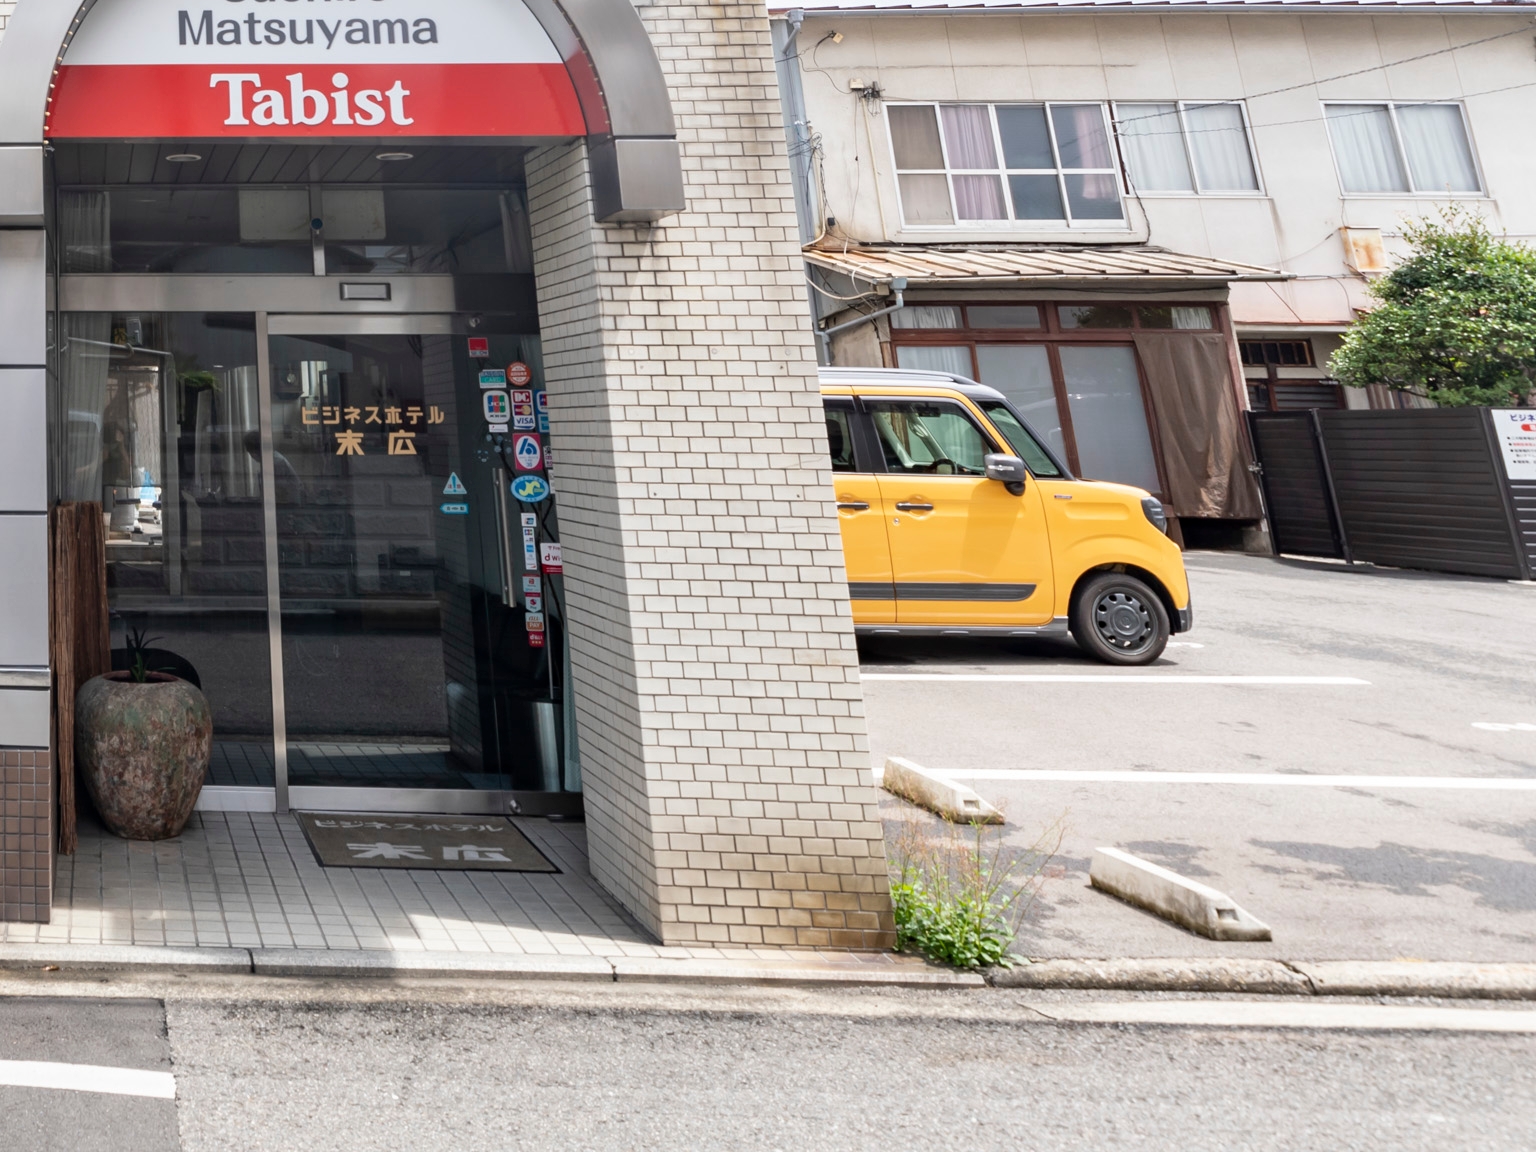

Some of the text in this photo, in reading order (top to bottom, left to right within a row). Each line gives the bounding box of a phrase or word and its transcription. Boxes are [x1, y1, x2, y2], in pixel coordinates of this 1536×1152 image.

[177, 9, 439, 50] Matsuyama
[209, 72, 415, 126] Tabist
[514, 392, 530, 402] DC
[301, 406, 445, 425] ビジネスホテル
[334, 429, 417, 456] 末広
[314, 819, 504, 832] ビジネスホテル
